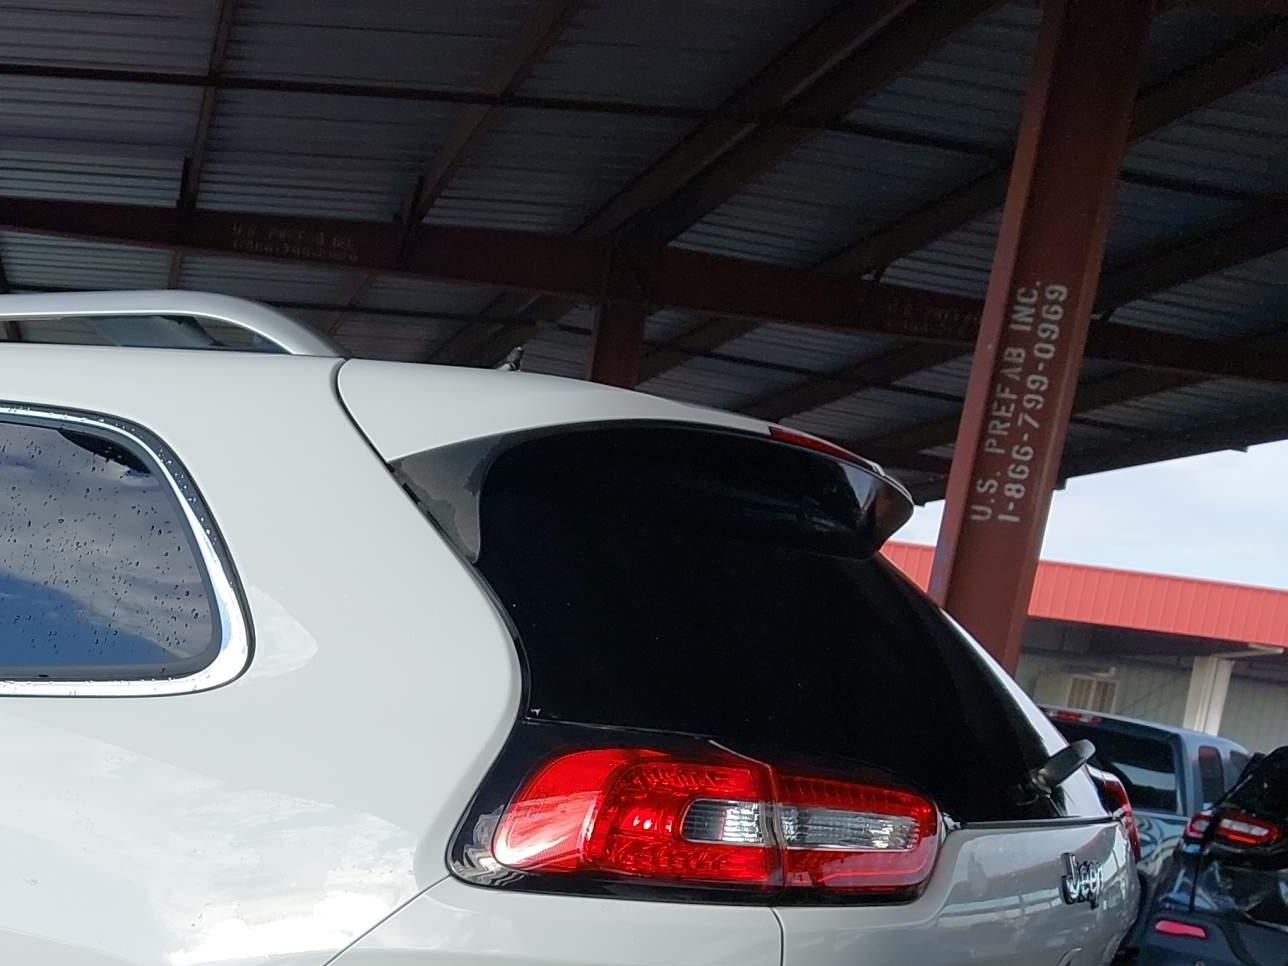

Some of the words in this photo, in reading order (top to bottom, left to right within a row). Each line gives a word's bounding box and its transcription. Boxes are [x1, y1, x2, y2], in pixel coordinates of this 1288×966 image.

[1009, 281, 1040, 331] INC.
[984, 346, 1026, 454] PREFAB
[997, 284, 1068, 522] 1-866-799-0969
[970, 471, 1001, 521] U.S.
[1061, 852, 1104, 910] Jeep
